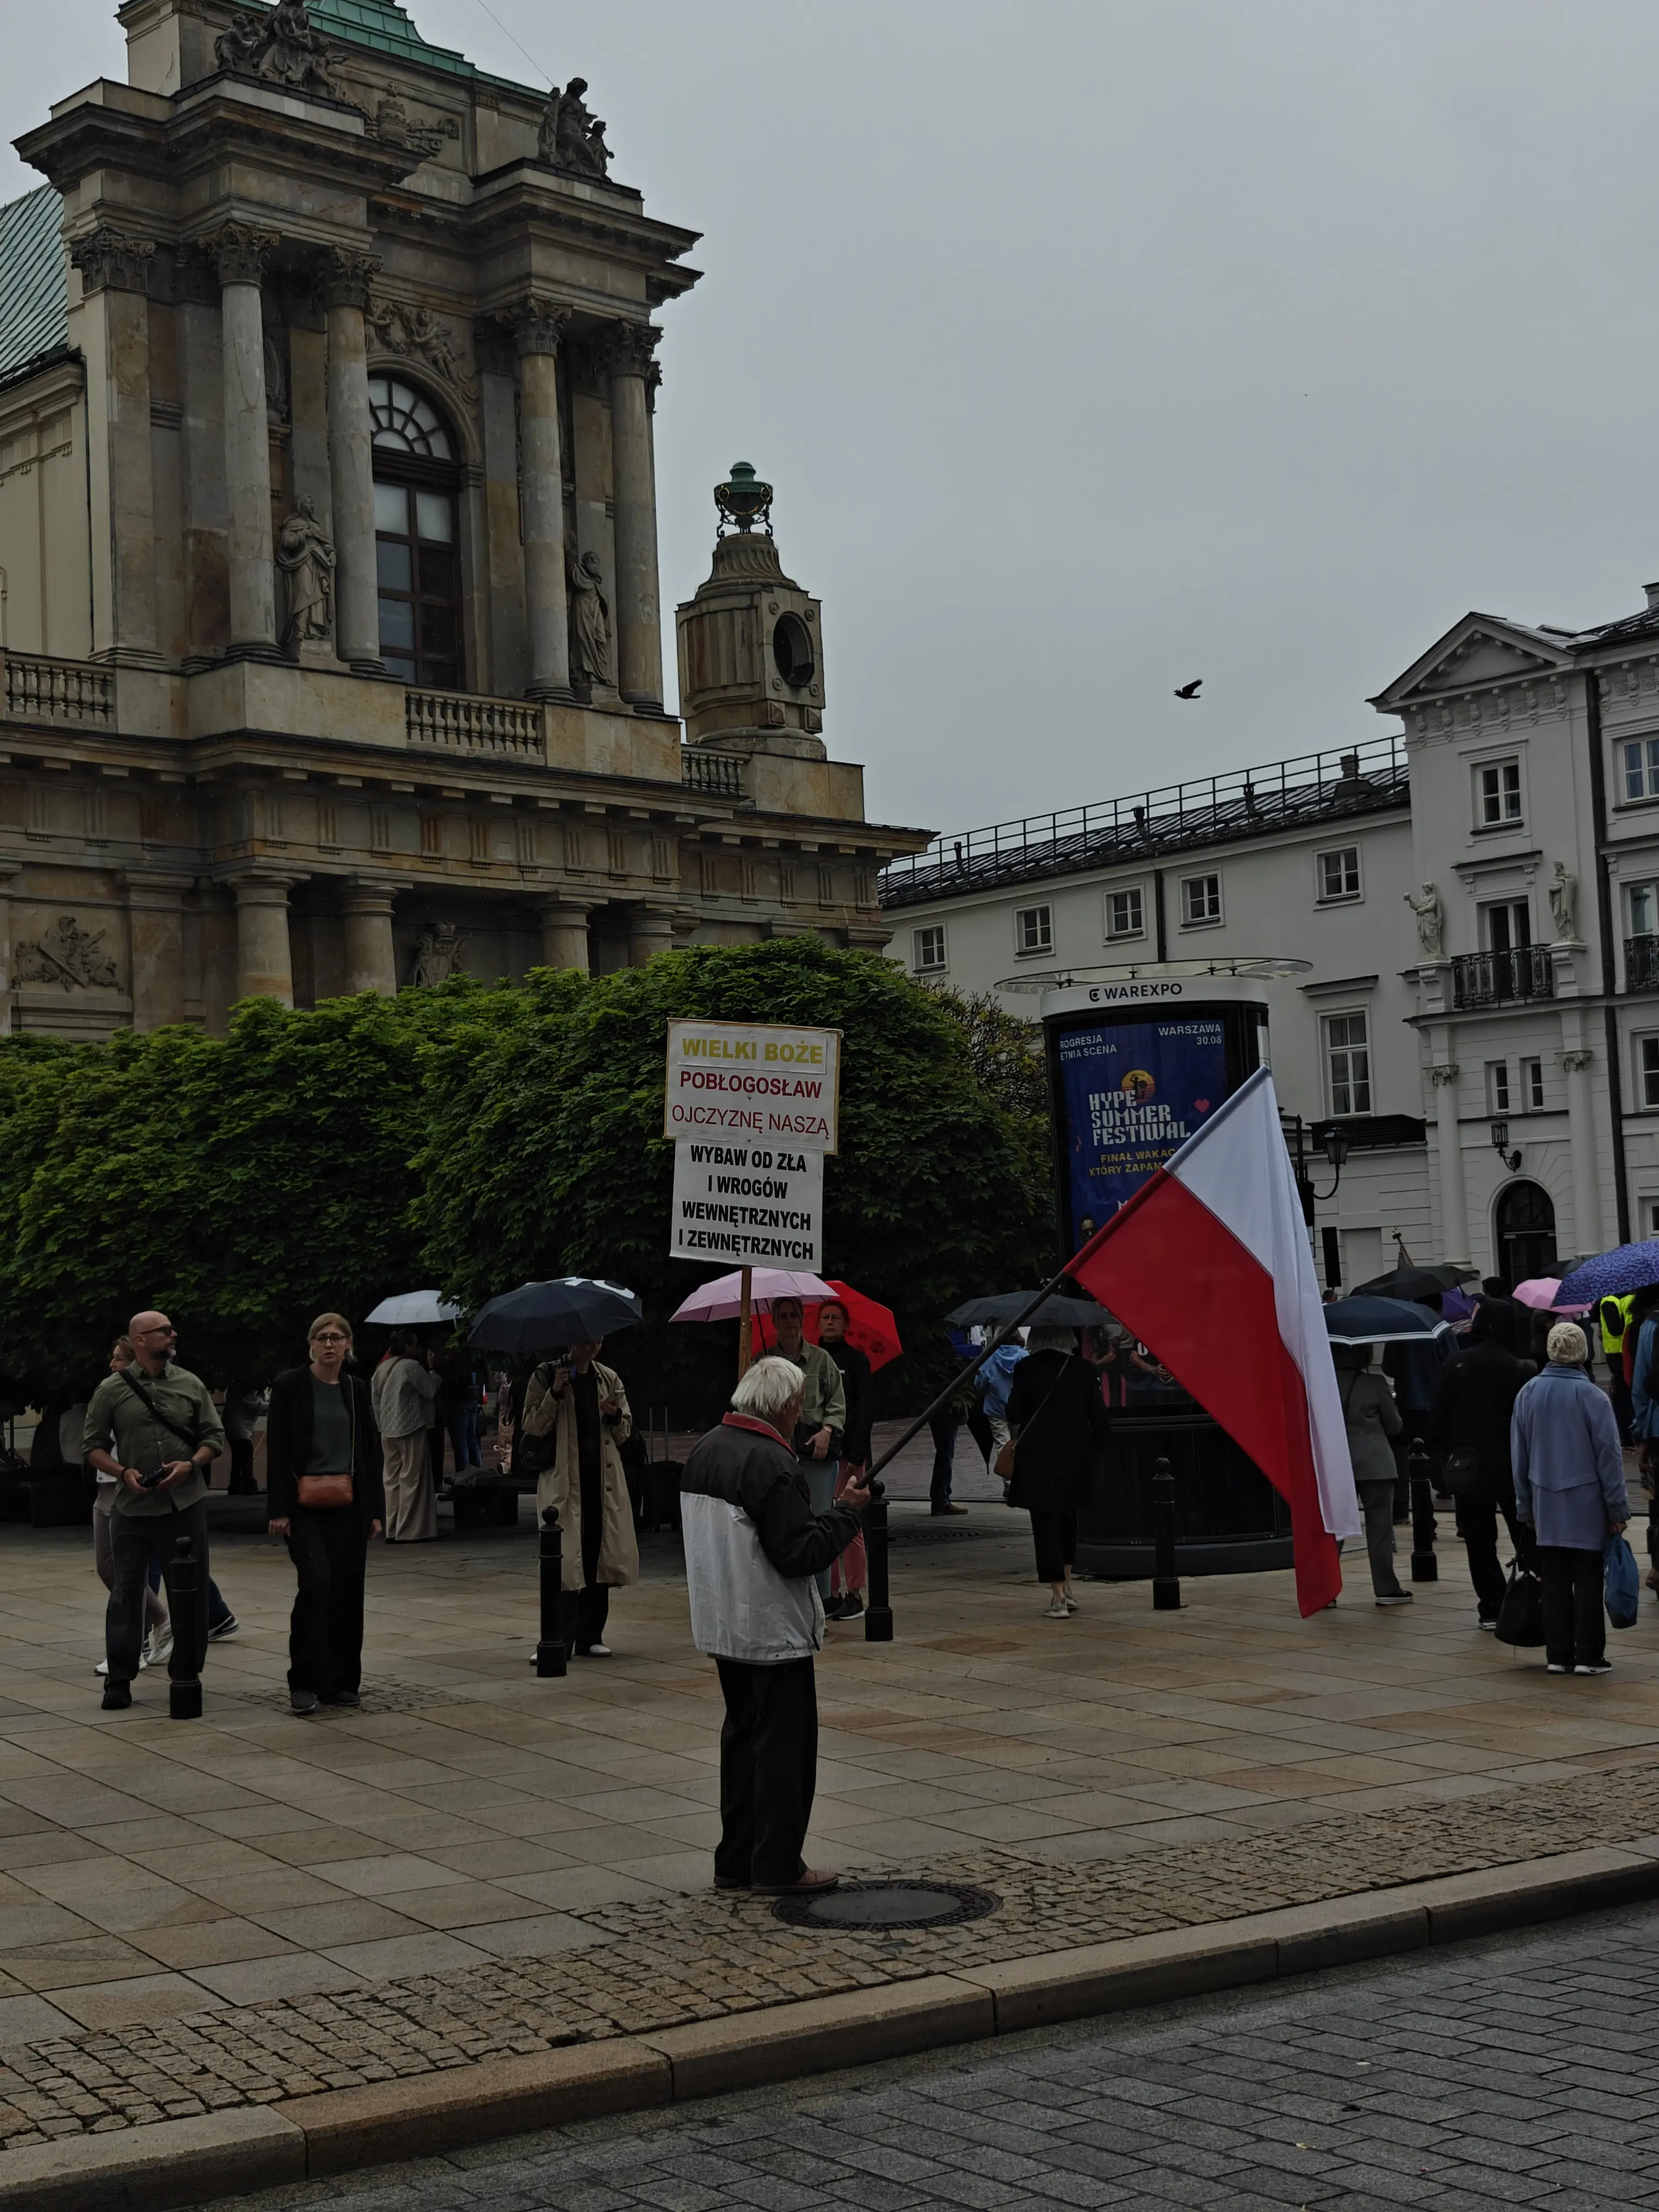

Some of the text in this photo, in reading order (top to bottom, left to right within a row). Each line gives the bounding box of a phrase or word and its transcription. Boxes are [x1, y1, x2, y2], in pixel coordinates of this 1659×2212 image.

[1104, 983, 1182, 999] WAREXPO
[1060, 1034, 1103, 1050] ROGRESJA
[1158, 1024, 1221, 1036] WARSZAWA
[1196, 1036, 1222, 1046] 30.08
[682, 1038, 823, 1064] WIELKI BOŻE
[1060, 1044, 1117, 1061] ETNIA SCENA
[680, 1071, 822, 1099] POBŁOGOSŁAW
[1089, 1090, 1137, 1111] HYPE
[672, 1105, 830, 1139] OJCZYZNĘ NASZĄ
[1091, 1104, 1171, 1128] SUMMER
[1092, 1121, 1191, 1146] FESTIWAL
[691, 1145, 807, 1172] WYBAW OD ZŁA
[1101, 1148, 1176, 1163] FINAŁ WAKAC
[1089, 1161, 1163, 1177] KTÓRY ZAPAM
[708, 1175, 788, 1199] I WROGÓW
[682, 1201, 811, 1231] WEWNĘTRZNYCH
[679, 1229, 813, 1260] I ZEWNĘTRZNYCH
